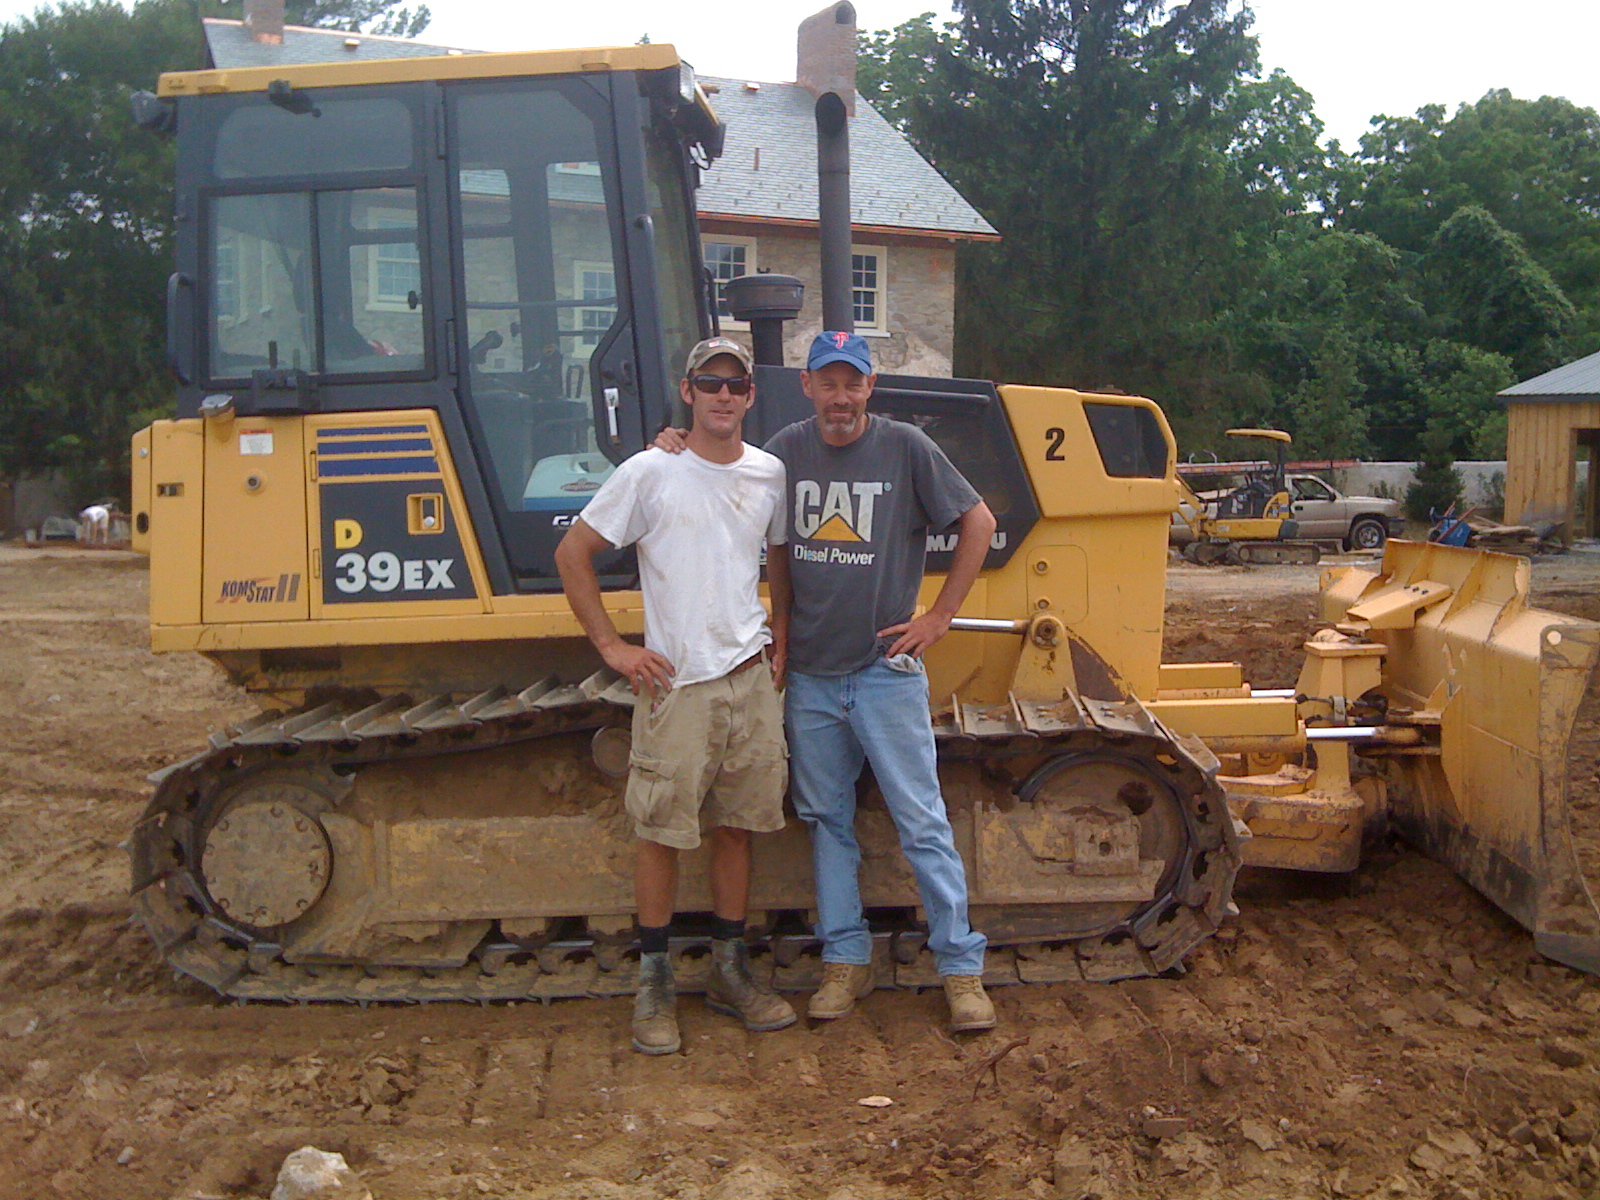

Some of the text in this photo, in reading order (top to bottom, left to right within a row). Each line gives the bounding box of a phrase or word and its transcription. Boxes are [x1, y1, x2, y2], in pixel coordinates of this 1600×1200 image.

[1045, 428, 1065, 461] 2
[795, 480, 883, 542] CAT
[335, 520, 363, 549] D
[794, 545, 875, 565] Diesel Power
[335, 551, 455, 593] 39EX
